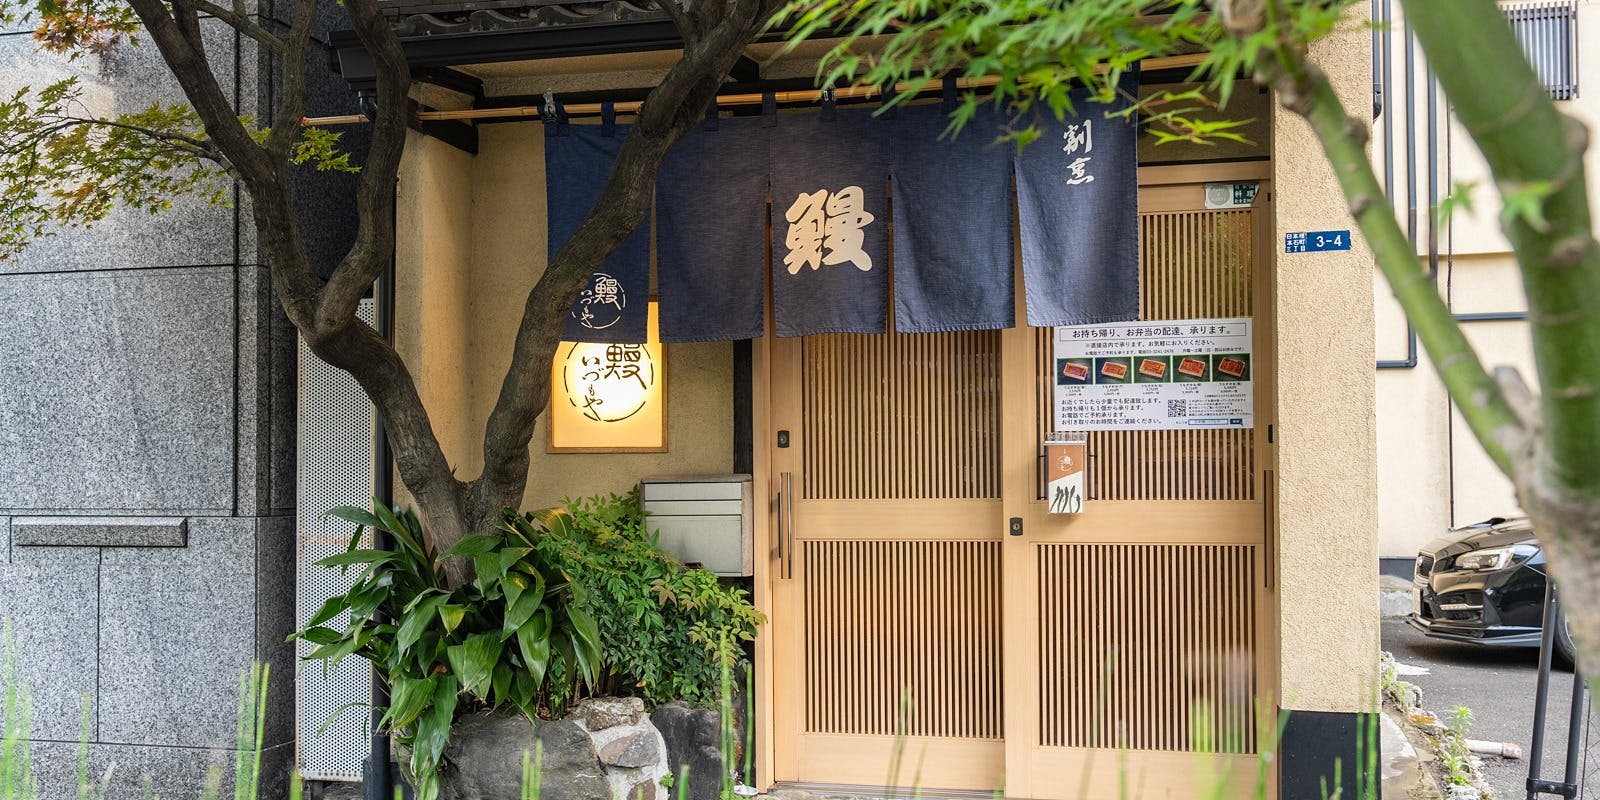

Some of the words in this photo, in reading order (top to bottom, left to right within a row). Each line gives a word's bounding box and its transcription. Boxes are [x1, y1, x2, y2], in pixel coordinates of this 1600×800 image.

[1062, 119, 1095, 185] 割烹
[783, 185, 874, 275] 鰻
[1316, 234, 1343, 248] 3-4
[1286, 245, 1306, 253] 三丁目
[594, 276, 622, 311] 鰻
[580, 289, 595, 328] いづもや
[1072, 325, 1231, 339] お持ち帰り、お弁当の配達、承ります。
[582, 356, 605, 421] いづもや
[1061, 397, 1161, 405] お近くでしたら少量でも配達致します。
[1061, 418, 1161, 426] お引き取りのお時間をご連絡ください。
